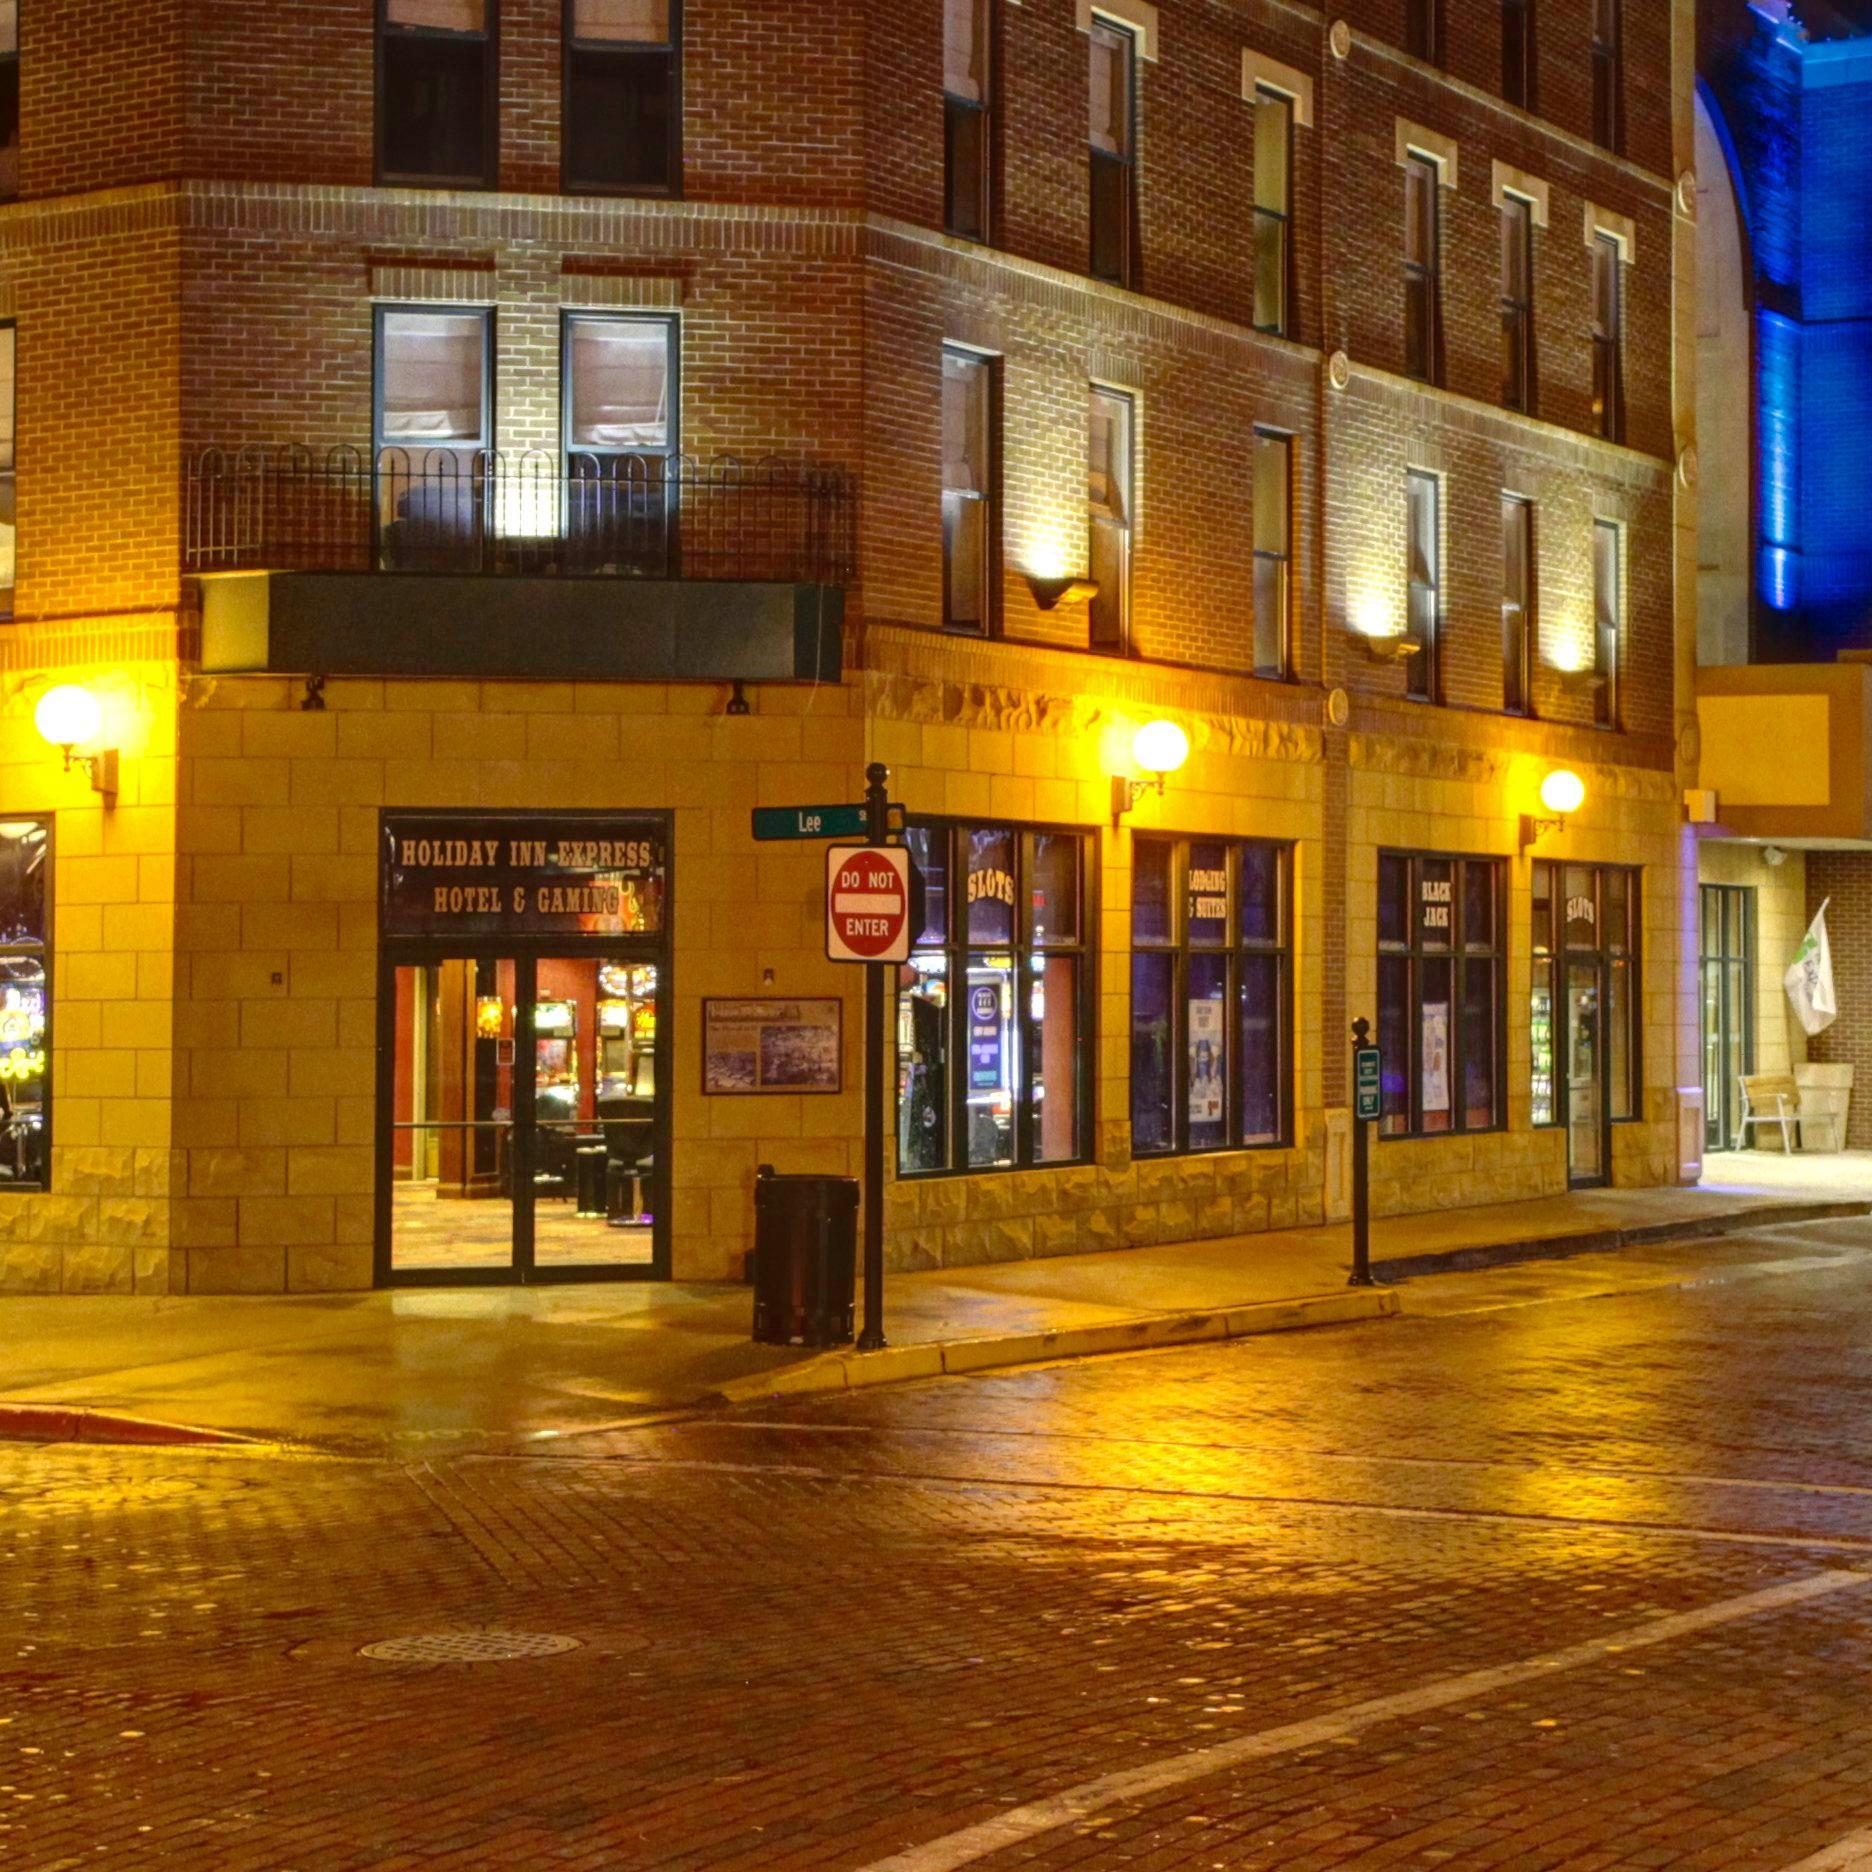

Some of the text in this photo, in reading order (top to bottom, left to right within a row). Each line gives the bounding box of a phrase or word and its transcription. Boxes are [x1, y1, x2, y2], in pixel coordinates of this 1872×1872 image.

[799, 811, 822, 832] Lee
[401, 839, 652, 868] HOLIDAY INN EXPRESS
[841, 872, 894, 888] DO NOT
[967, 868, 1014, 908] SLOTS
[1188, 869, 1226, 892] LODGING
[433, 886, 502, 913] HOTEL
[537, 886, 620, 914] GAMING
[1422, 881, 1451, 902] BLACK
[1424, 906, 1449, 927] JACK
[1566, 897, 1595, 924] SLOTS
[846, 918, 889, 936] ENTER
